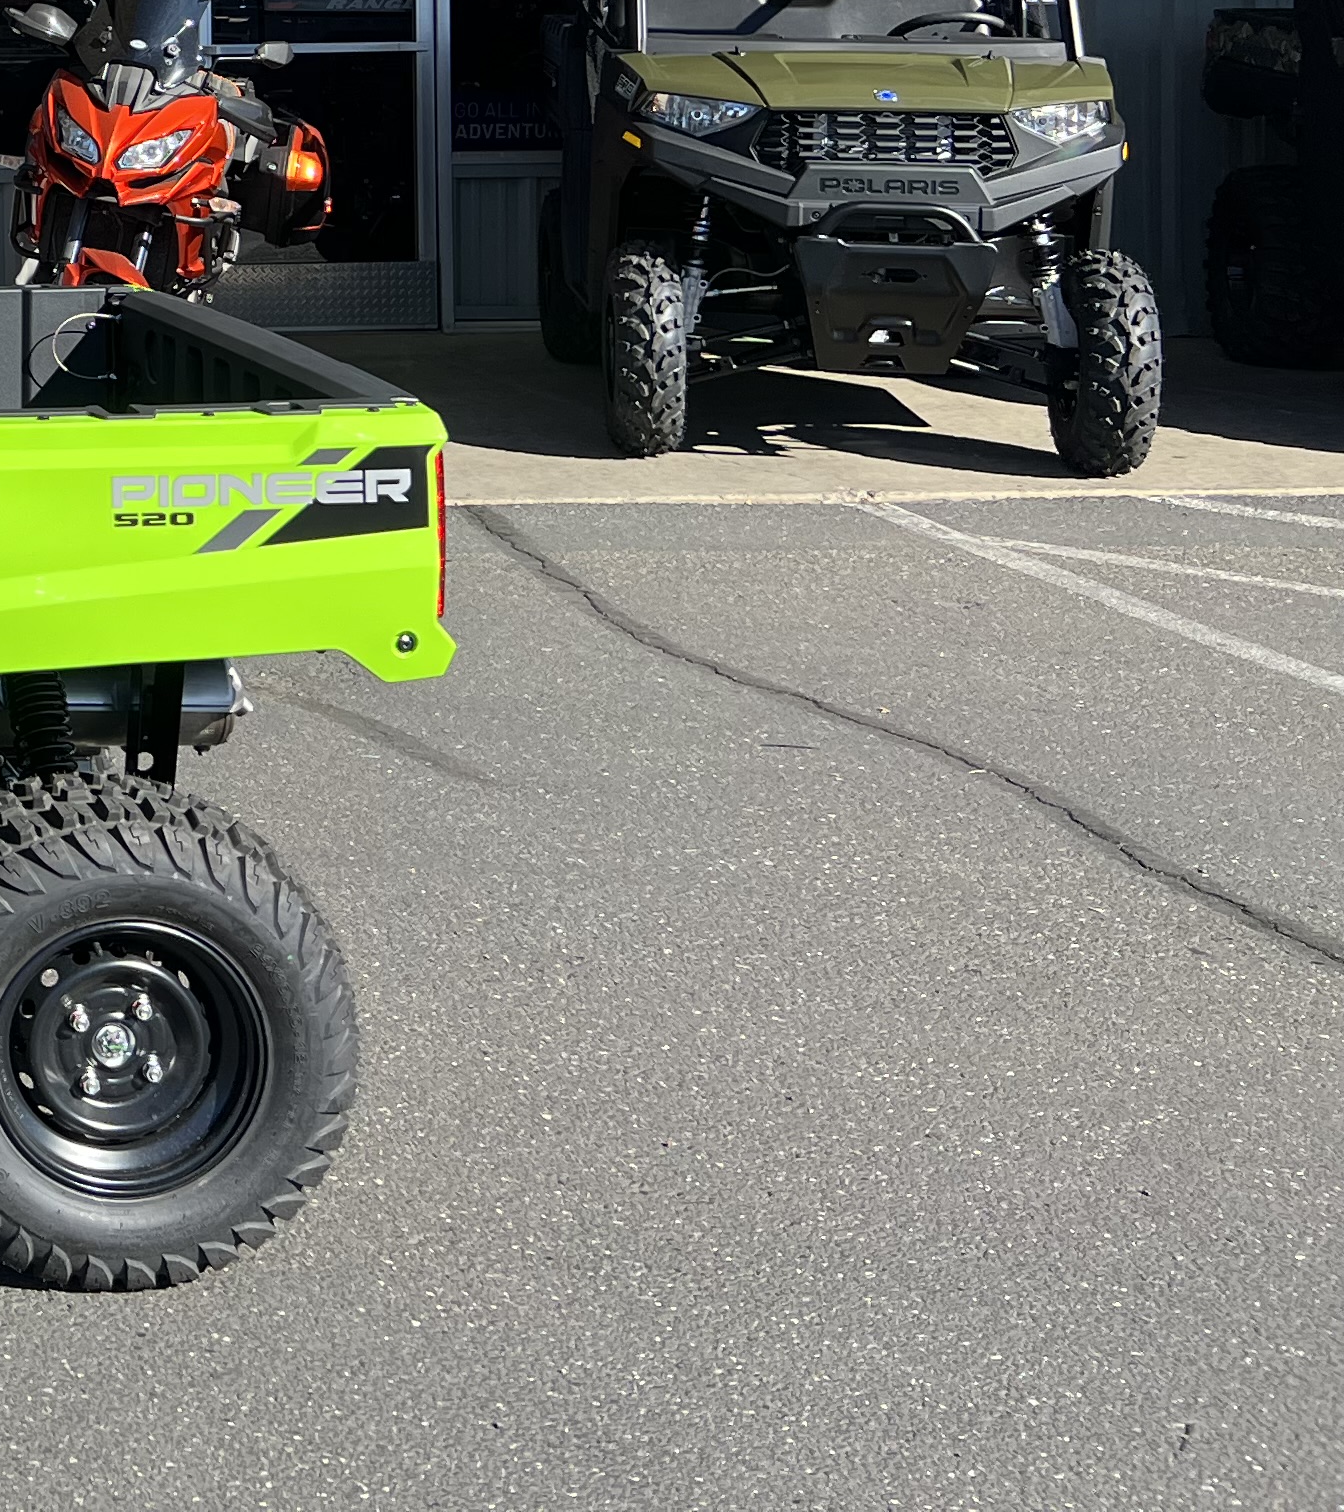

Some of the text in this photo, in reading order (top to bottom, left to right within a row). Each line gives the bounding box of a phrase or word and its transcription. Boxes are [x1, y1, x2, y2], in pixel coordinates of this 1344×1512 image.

[455, 101, 480, 119] GO
[484, 101, 521, 119] ALL
[819, 177, 961, 196] POLARIS
[112, 468, 412, 508] PIONEER
[113, 512, 195, 527] 520
